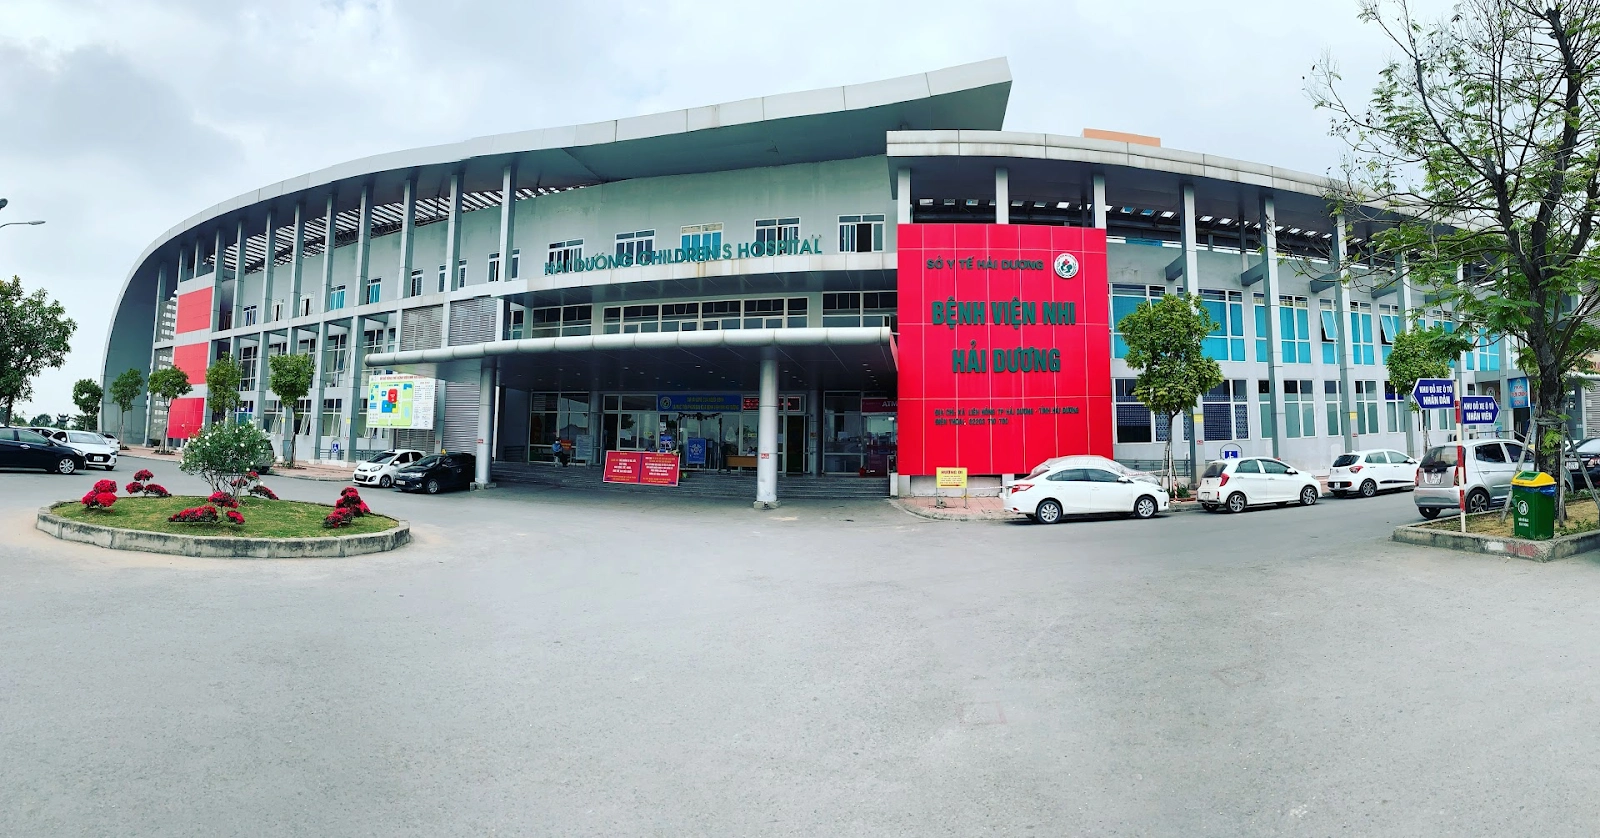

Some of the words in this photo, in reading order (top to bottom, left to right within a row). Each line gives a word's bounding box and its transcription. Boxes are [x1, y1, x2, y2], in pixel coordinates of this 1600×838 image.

[738, 238, 822, 259] HOSPITAL
[947, 259, 955, 270] Y
[931, 296, 986, 330] BỆNH
[991, 296, 1037, 330] VIỆN
[1042, 301, 1076, 326] NHI
[952, 339, 987, 373] HẢI
[993, 347, 1061, 373] DƯƠNG
[1419, 385, 1429, 394] KHU
[1436, 385, 1443, 394] XE
[1463, 402, 1473, 410] KHU
[1479, 402, 1485, 410] XE
[1466, 410, 1481, 421] NHÂN
[1481, 410, 1493, 421] VIÊN
